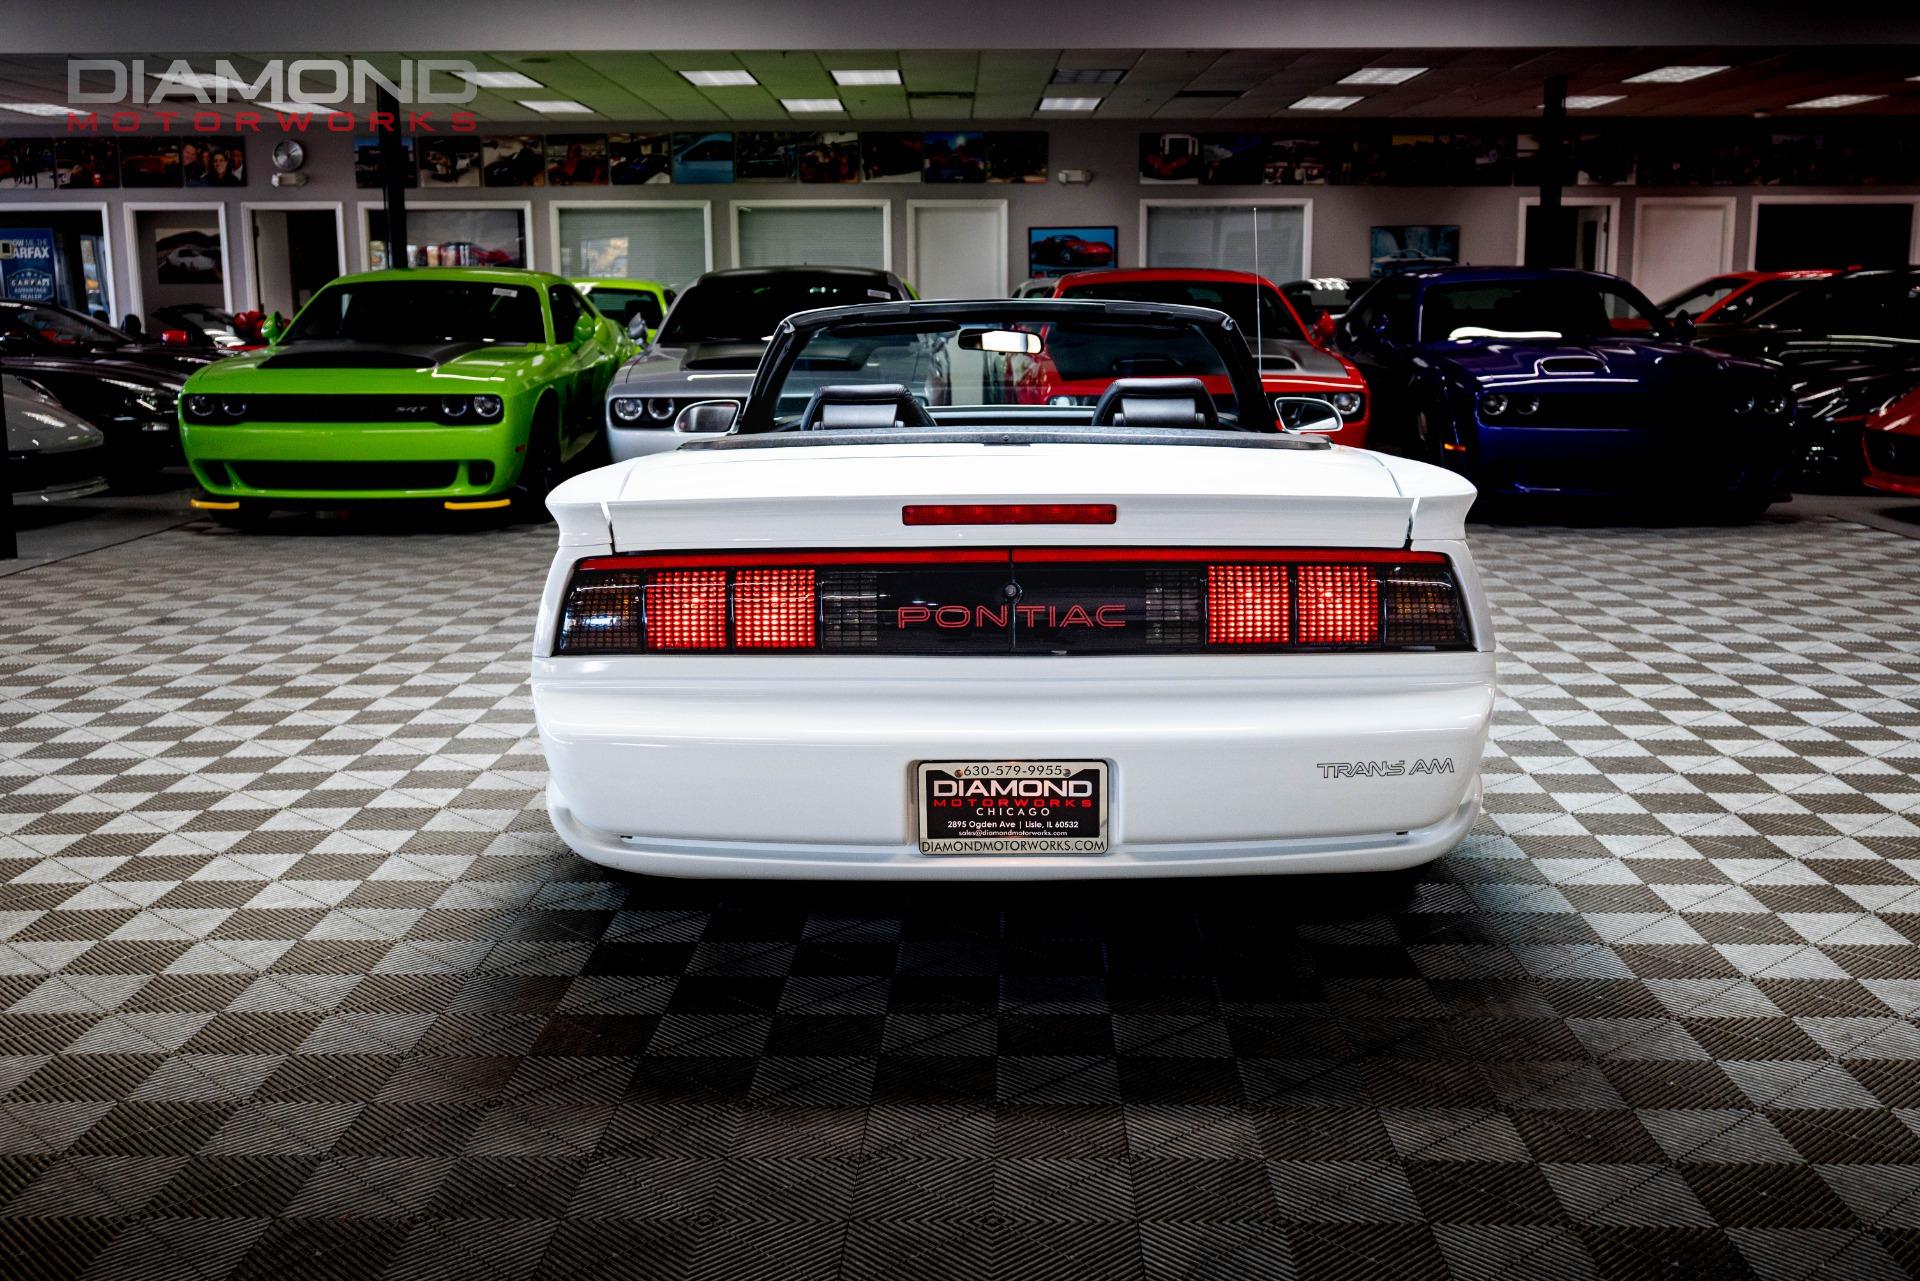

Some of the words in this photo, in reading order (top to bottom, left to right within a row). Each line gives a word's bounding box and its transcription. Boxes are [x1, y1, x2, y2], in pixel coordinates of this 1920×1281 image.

[12, 246, 50, 259] ARFAX
[897, 605, 1126, 629] PONTIAC
[963, 765, 1062, 776] 630-579-9955
[1317, 760, 1405, 779] TRANS
[1409, 757, 1455, 775] AM
[933, 780, 1093, 797] DIAMOND
[933, 799, 1093, 808] MOTORWORKS
[976, 807, 1050, 816] CHICAGO
[947, 820, 967, 828] 2895
[969, 820, 998, 830] Ogden
[999, 820, 1016, 828] Ave
[1047, 820, 1053, 828] IL
[1055, 820, 1079, 828] 60532
[922, 840, 1105, 852] DIAMONDMOTORWORKS.COM
